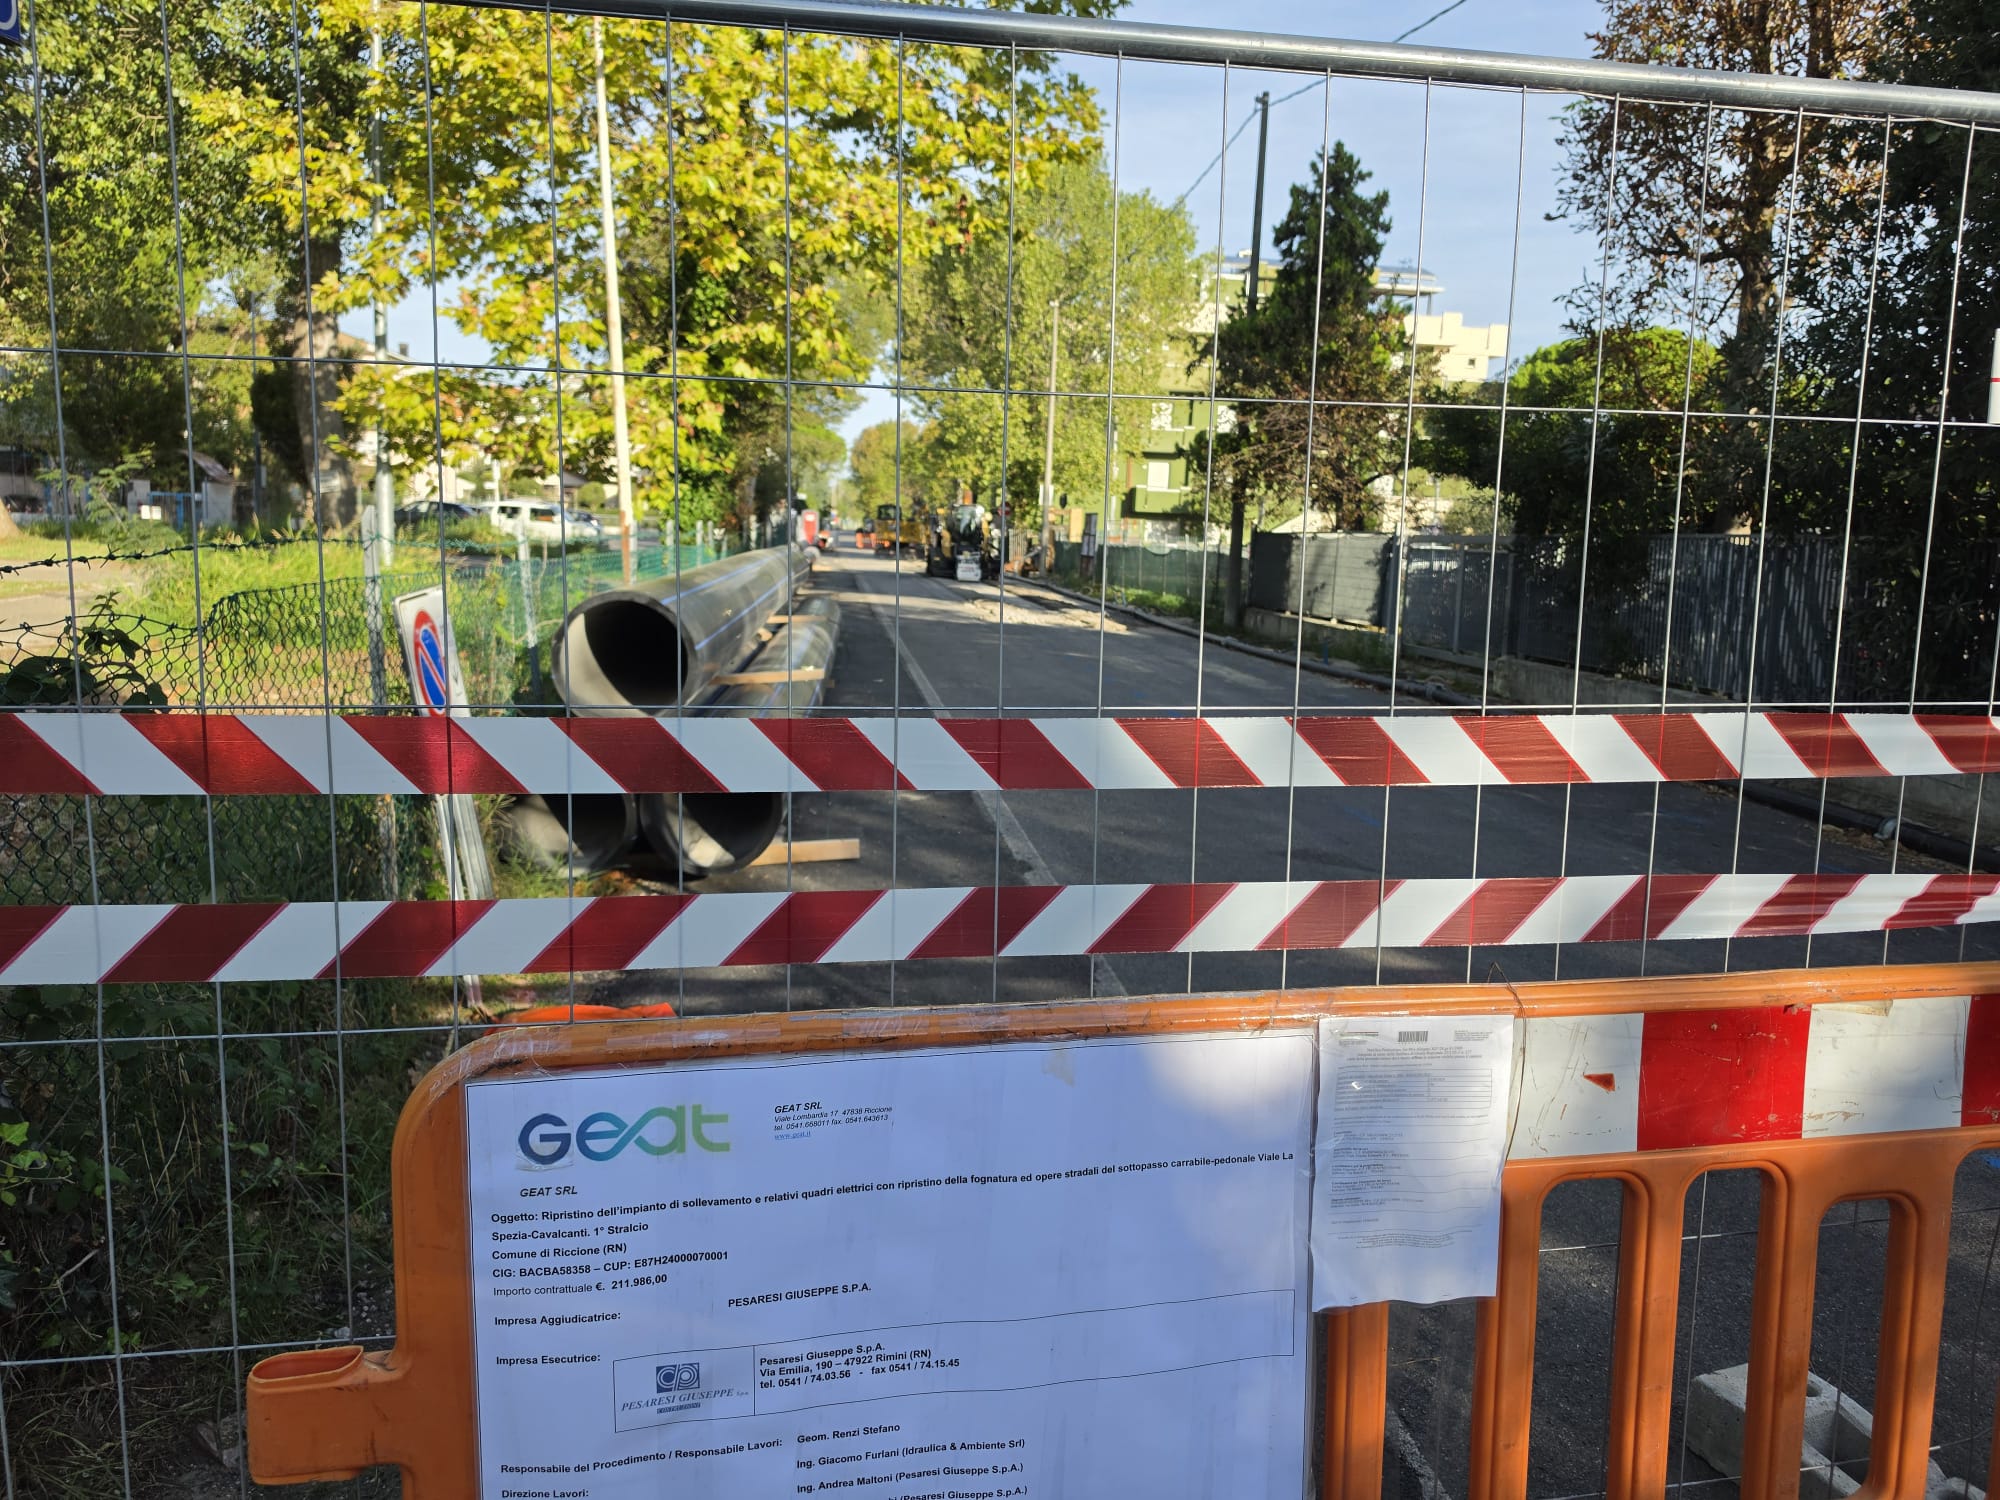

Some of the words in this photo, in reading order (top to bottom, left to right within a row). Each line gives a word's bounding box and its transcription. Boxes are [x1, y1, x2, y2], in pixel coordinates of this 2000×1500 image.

[774, 1103, 801, 1114] GEAT
[803, 1101, 823, 1111] SRL
[774, 1114, 791, 1123] Viale
[864, 1105, 893, 1114] Riccione
[491, 1212, 539, 1225] Oggetto:
[541, 1208, 594, 1222] Ripristino
[669, 1199, 680, 1209] di
[682, 1195, 752, 1208] sollevamento
[754, 1196, 762, 1204] e
[764, 1190, 799, 1204] relativi
[801, 1186, 834, 1200] quadri
[836, 1181, 874, 1195] elettrici
[876, 1181, 895, 1191] con
[898, 1177, 942, 1191] ripristino
[944, 1174, 968, 1185] della
[970, 1174, 1018, 1186] fognatura
[1020, 1173, 1032, 1182] ed
[1035, 1171, 1063, 1183] opere
[1064, 1166, 1099, 1178] stradali
[1101, 1164, 1116, 1175] del
[1118, 1160, 1169, 1174] sottopasso
[1171, 1153, 1256, 1169] carrabile-pedonale
[1257, 1152, 1281, 1163] Viale
[1282, 1151, 1294, 1161] La
[519, 1187, 552, 1198] GEAT
[555, 1185, 578, 1196] SRL
[491, 1227, 591, 1243] Spezia-Cavalcanti.
[593, 1226, 605, 1237] 1°
[607, 1221, 649, 1235] Stralcio
[492, 1250, 537, 1260] Comune
[540, 1248, 550, 1258] di
[553, 1246, 600, 1258] Riccione
[603, 1242, 627, 1256] (RN)
[492, 1268, 516, 1278] CIG:
[519, 1264, 591, 1277] BACBA58358
[603, 1261, 631, 1272] CUP:
[634, 1250, 729, 1269] E87H24000070001
[493, 1286, 531, 1298] Importo
[534, 1283, 593, 1295] contrattuale
[611, 1273, 668, 1290] 211.986,00
[728, 1292, 783, 1308] PESARESI
[785, 1285, 839, 1301] GIUSEPPE
[841, 1282, 872, 1294] S.P.A.
[494, 1316, 537, 1328] Impresa
[540, 1311, 621, 1326] Aggiudicatrice:
[496, 1355, 539, 1367] Impresa
[541, 1353, 601, 1365] Esecutrice:
[760, 1353, 804, 1366] Pesaresi
[806, 1347, 854, 1362] Giuseppe
[856, 1342, 885, 1355] S.p.A.
[760, 1367, 776, 1378] Via
[778, 1365, 812, 1376] Emilia,
[815, 1360, 833, 1371] 190
[844, 1355, 873, 1367] 47922
[875, 1351, 907, 1363] Rimini
[909, 1348, 932, 1360] (RN)
[760, 1379, 776, 1389] tel.
[778, 1376, 801, 1388] 0541
[810, 1369, 851, 1383] 74.03.56
[871, 1365, 886, 1375] fax
[889, 1361, 912, 1373] 0541
[919, 1357, 960, 1370] 74.15.45
[621, 1395, 677, 1412] PESARESI
[679, 1388, 734, 1403] GIUSEPPE
[797, 1432, 830, 1444] Geom.
[832, 1427, 860, 1440] Renzi
[863, 1423, 901, 1436] Stefano
[501, 1463, 571, 1476] Responsabile
[574, 1462, 590, 1473] del
[593, 1451, 666, 1471] Procedimento
[675, 1443, 745, 1459] Responsabile
[747, 1437, 783, 1451] Lavori:
[797, 1458, 815, 1470] Ing.
[818, 1453, 863, 1466] Giacomo
[865, 1447, 899, 1460] Furlani
[902, 1442, 947, 1458] (Idraulica
[949, 1441, 957, 1451] &
[960, 1440, 1006, 1451] Ambiente
[1008, 1438, 1026, 1449] Srl)
[797, 1483, 816, 1495] Ing.
[818, 1479, 855, 1490] Andrea
[857, 1473, 893, 1486] Maltoni
[895, 1467, 941, 1482] (Pesaresi
[943, 1465, 990, 1476] Giuseppe
[992, 1462, 1024, 1475] S.p.A.)
[501, 1488, 551, 1499] Direzione
[553, 1487, 589, 1499] Lavori:
[947, 1490, 994, 1500] Giuseppe
[996, 1485, 1028, 1498] S.p.A.)
